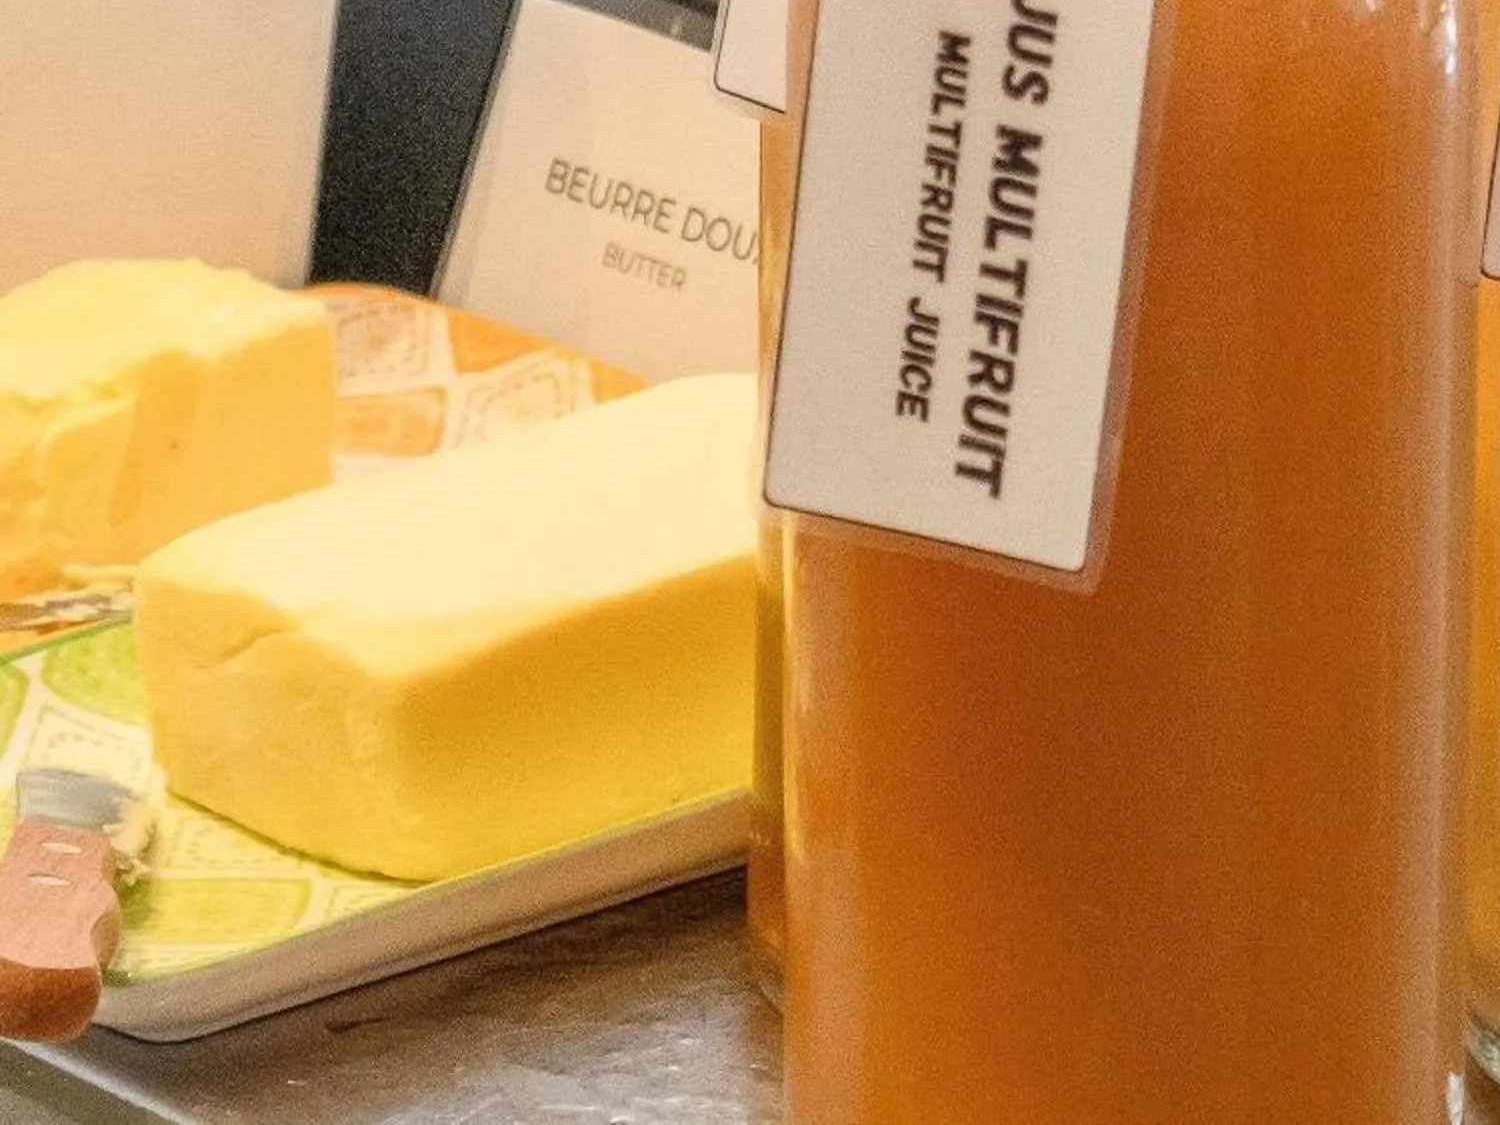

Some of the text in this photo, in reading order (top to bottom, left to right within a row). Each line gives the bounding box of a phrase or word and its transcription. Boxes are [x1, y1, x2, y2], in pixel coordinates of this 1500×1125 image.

[545, 157, 760, 266] BEURRE DOU
[602, 241, 688, 291] BUTTER
[895, 30, 972, 423] MULTIFRUIT JUICE
[954, 124, 1043, 501] MULTIFRUIT
